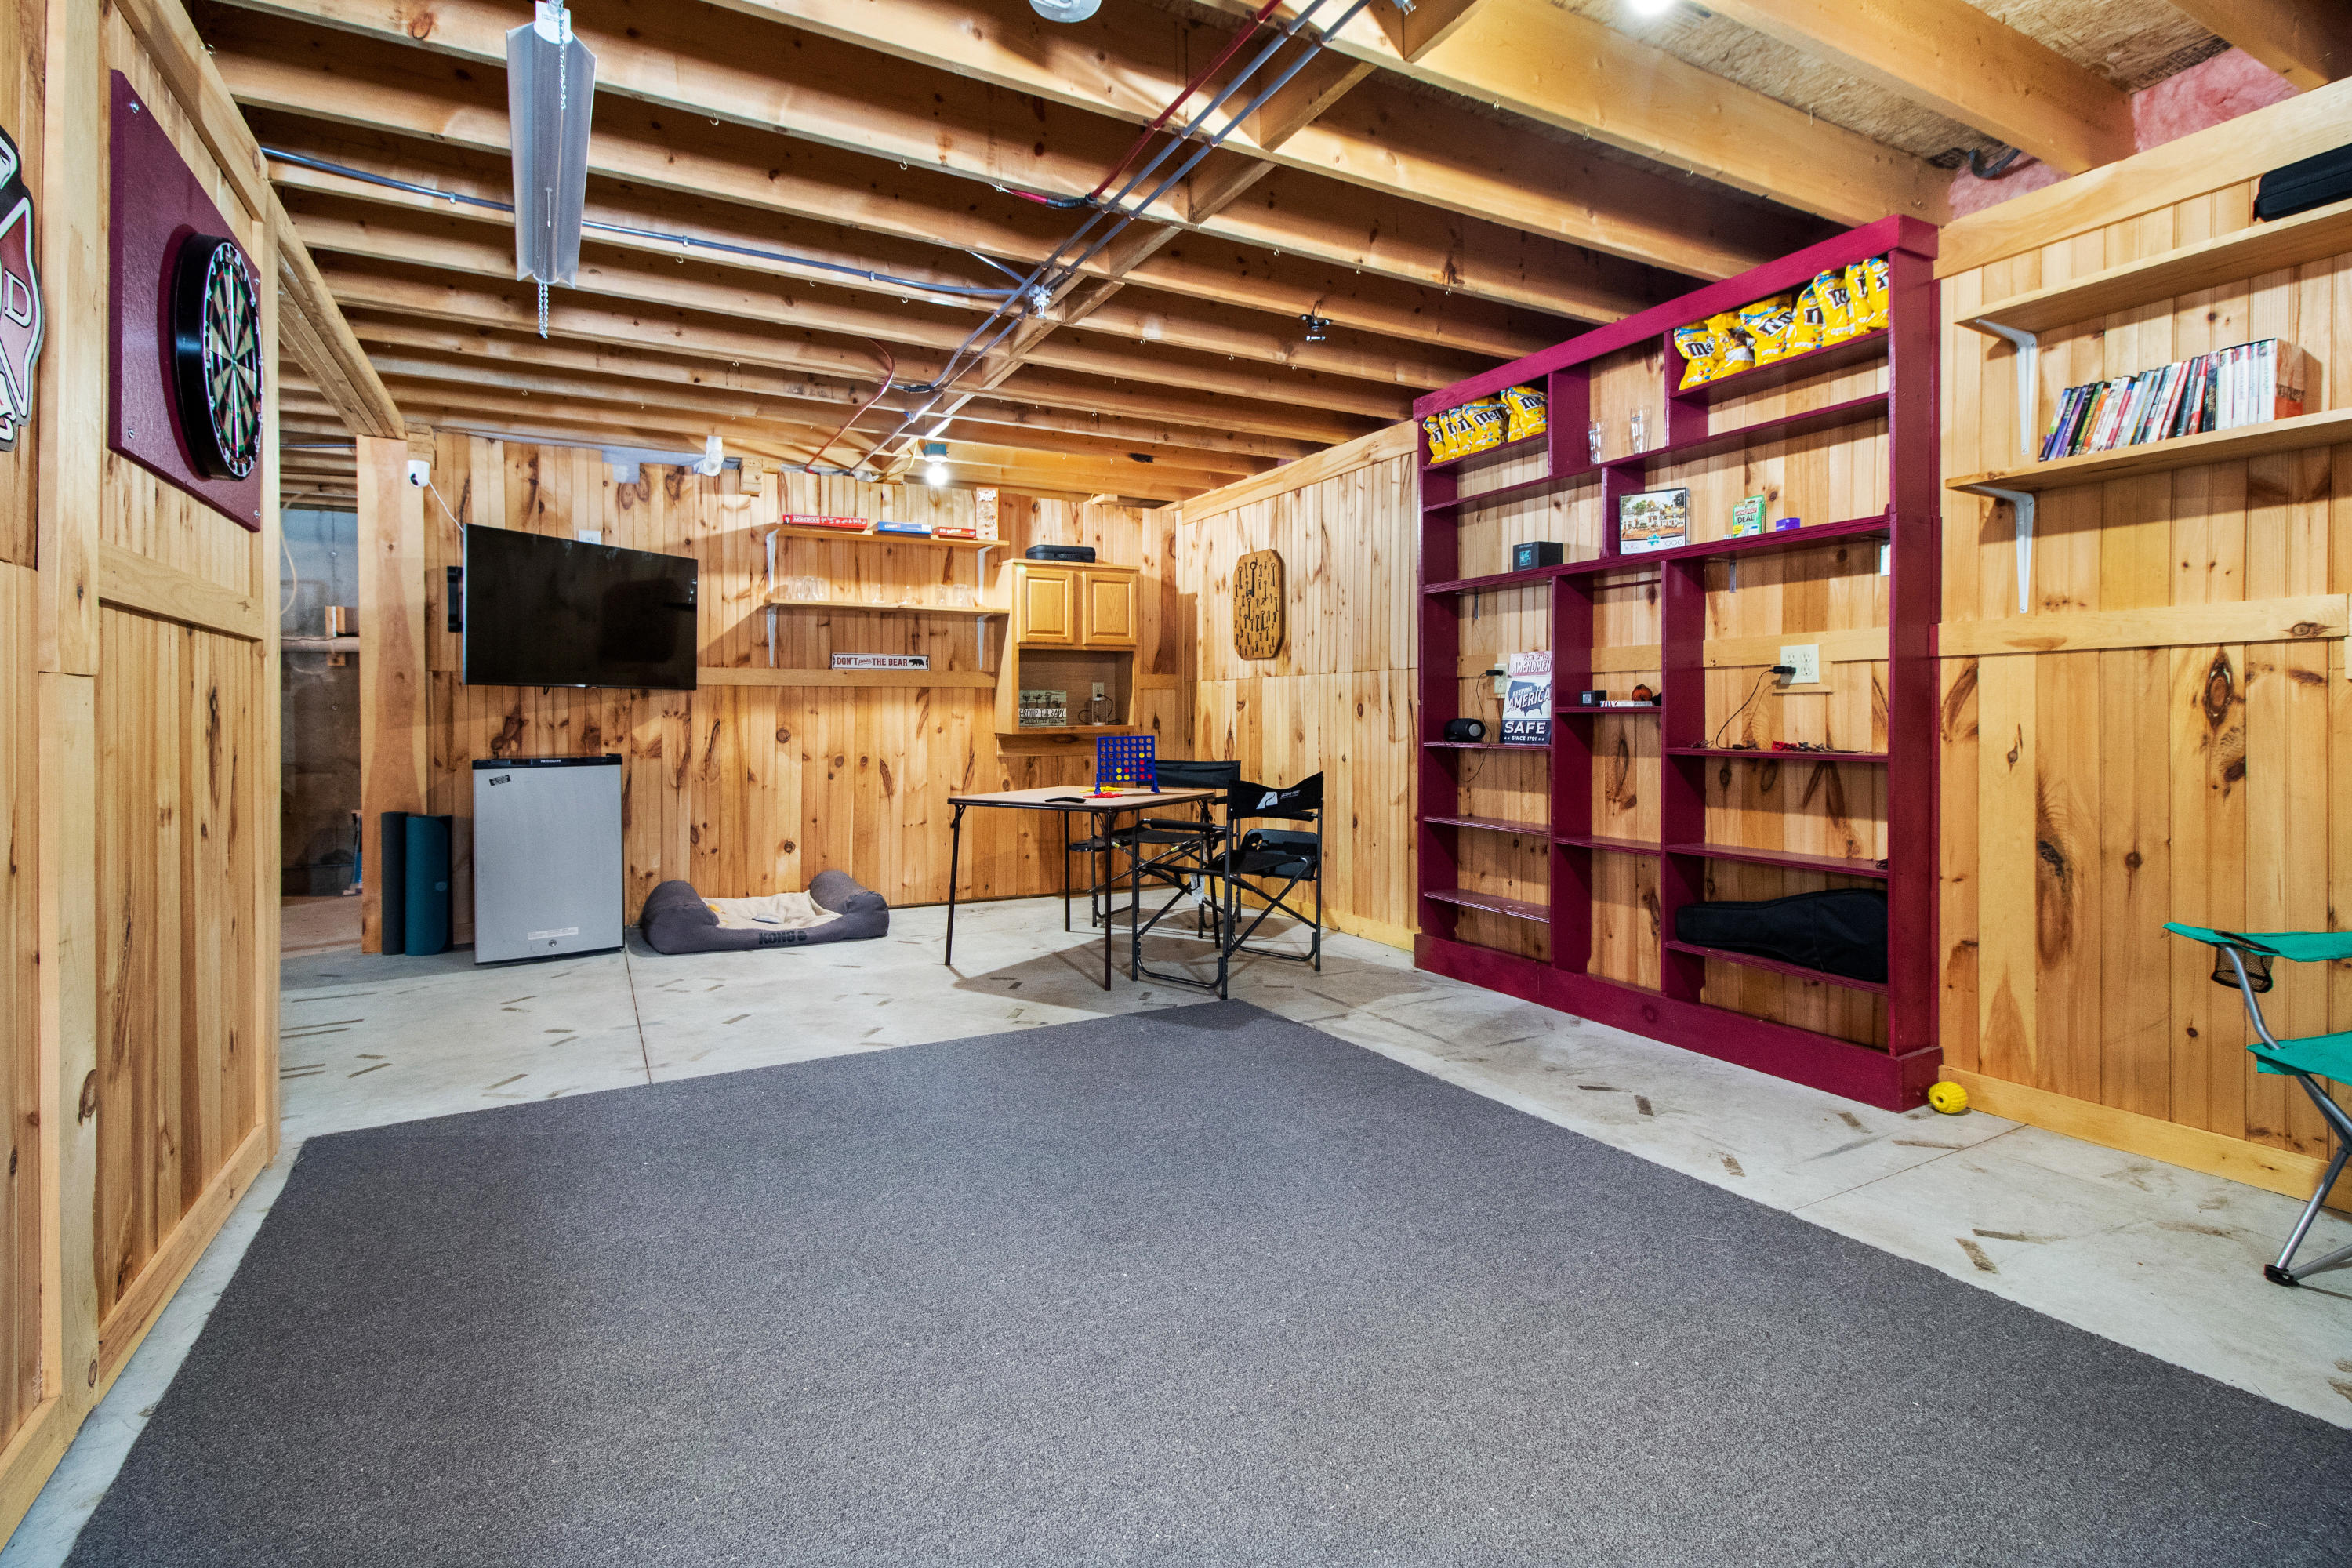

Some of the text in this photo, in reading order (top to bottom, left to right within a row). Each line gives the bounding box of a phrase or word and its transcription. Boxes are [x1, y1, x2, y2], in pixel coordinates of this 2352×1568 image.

[5, 270, 33, 328] D
[1737, 515, 1755, 524] DEAL
[837, 657, 858, 666] DON'T
[1512, 660, 1551, 673] AMENDMEN
[1512, 685, 1534, 697] KEEPING
[1508, 688, 1551, 712] AMERICA
[1040, 709, 1065, 718] THERAPY
[1504, 720, 1546, 735] SAFE
[759, 931, 796, 945] KONG
